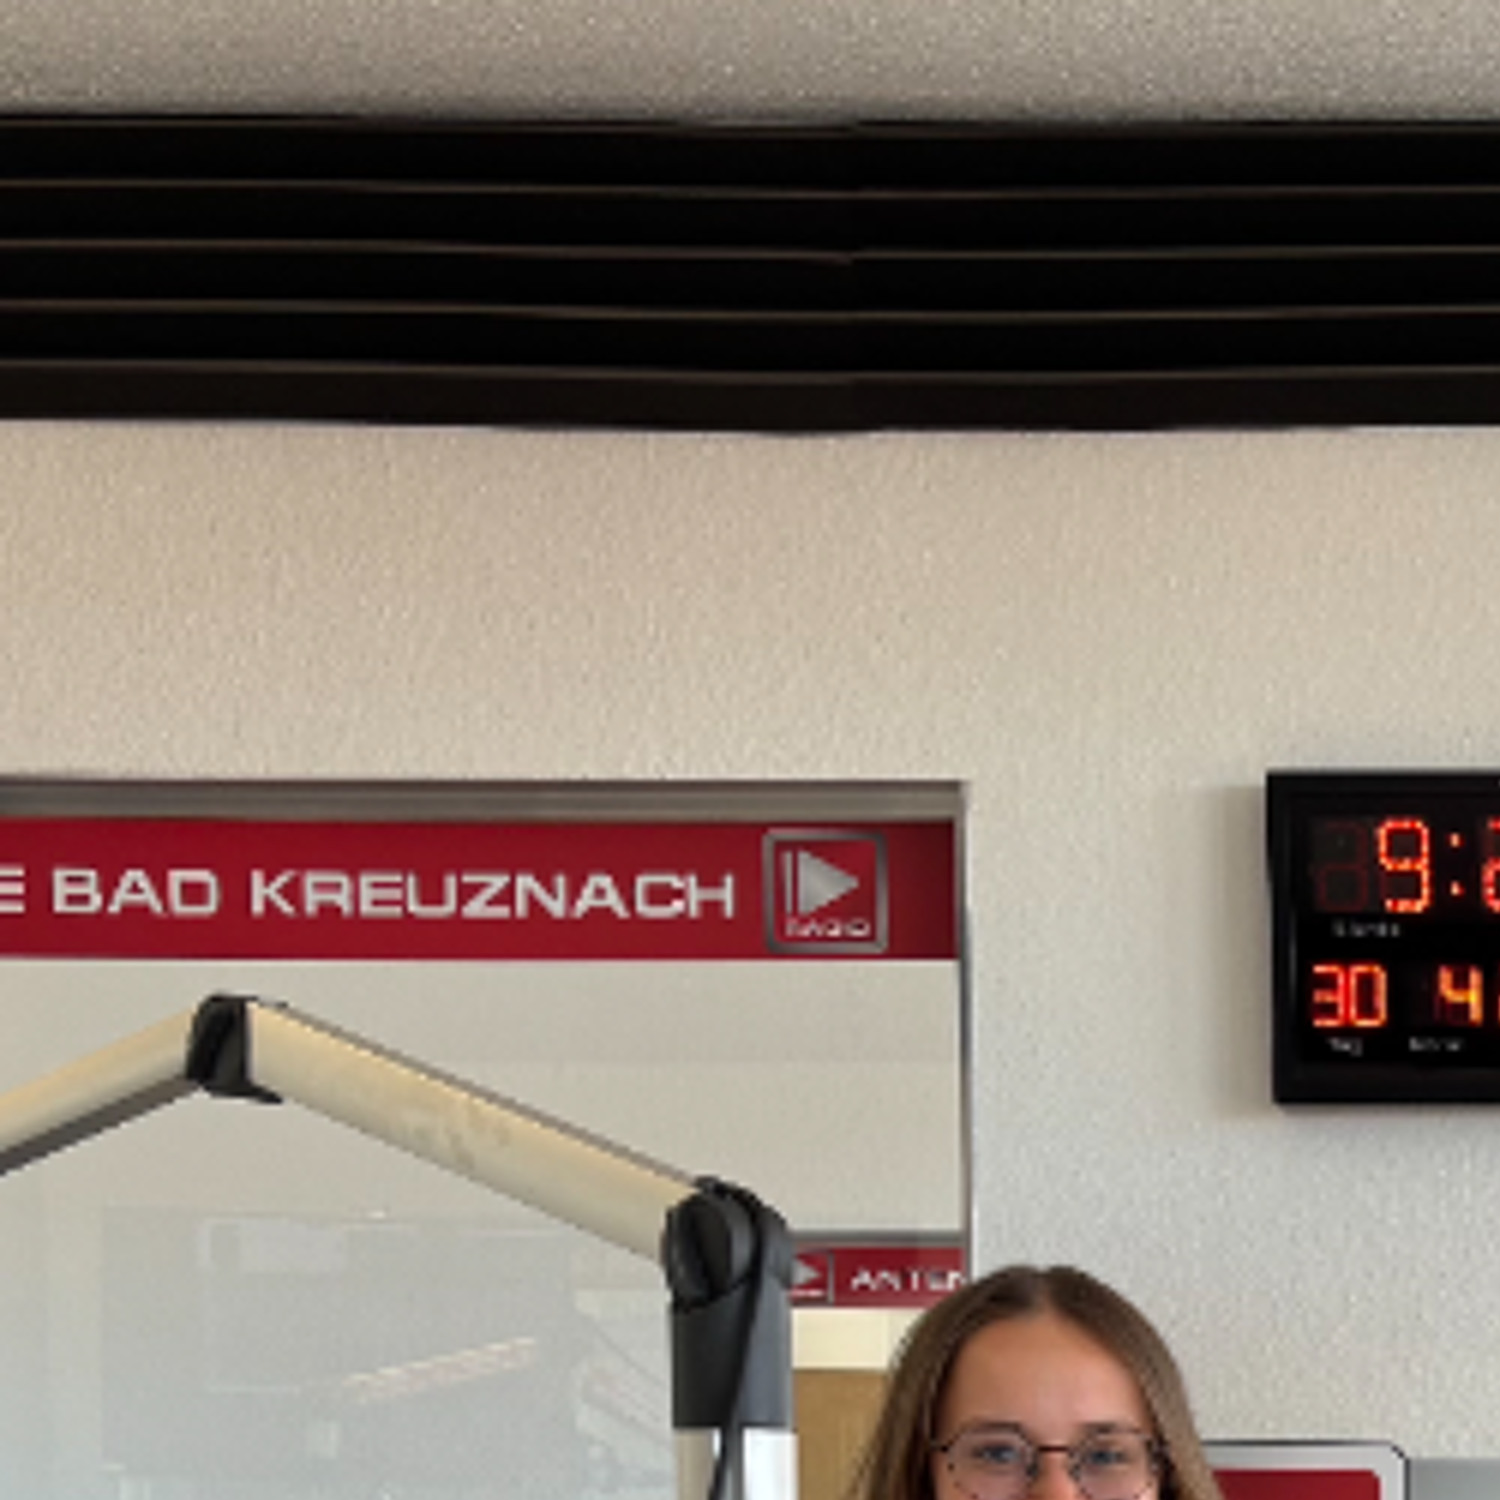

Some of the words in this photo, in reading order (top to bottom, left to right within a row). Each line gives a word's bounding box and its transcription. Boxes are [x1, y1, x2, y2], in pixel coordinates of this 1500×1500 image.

[53, 867, 220, 915] BAD
[251, 869, 736, 919] KREUZNACH
[1312, 963, 1388, 1028] 30
[1438, 964, 1484, 1026] 4
